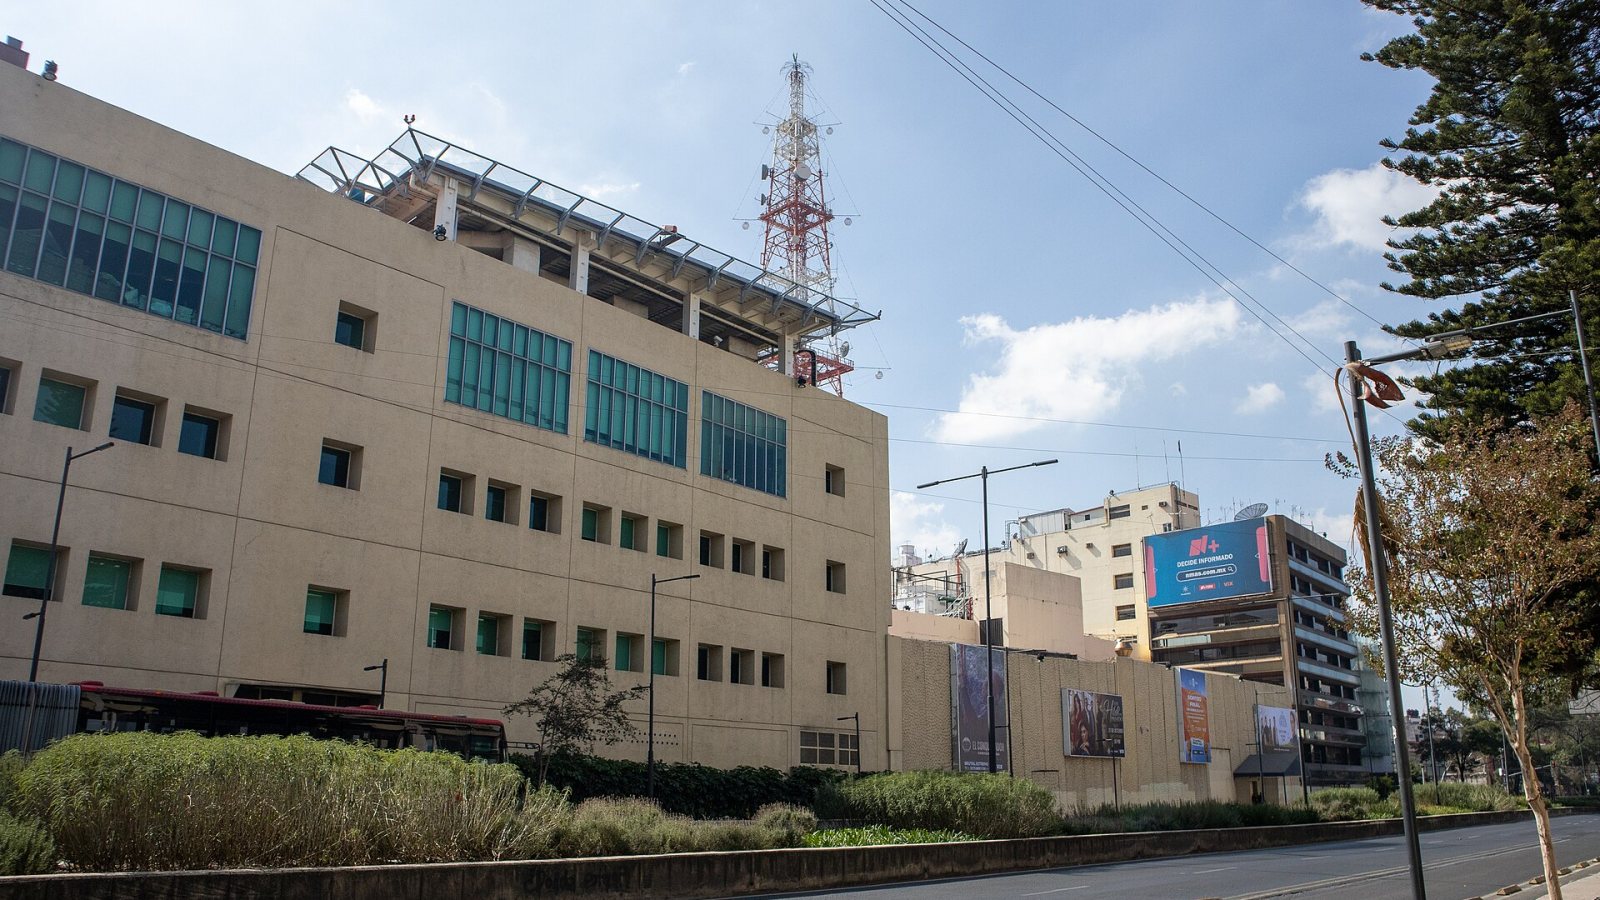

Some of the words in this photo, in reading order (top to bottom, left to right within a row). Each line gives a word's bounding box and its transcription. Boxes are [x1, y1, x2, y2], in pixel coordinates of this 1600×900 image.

[1177, 559, 1198, 568] DECIDE
[1198, 553, 1233, 564] INFORMADO
[1185, 567, 1227, 578] nmas.com.mx
